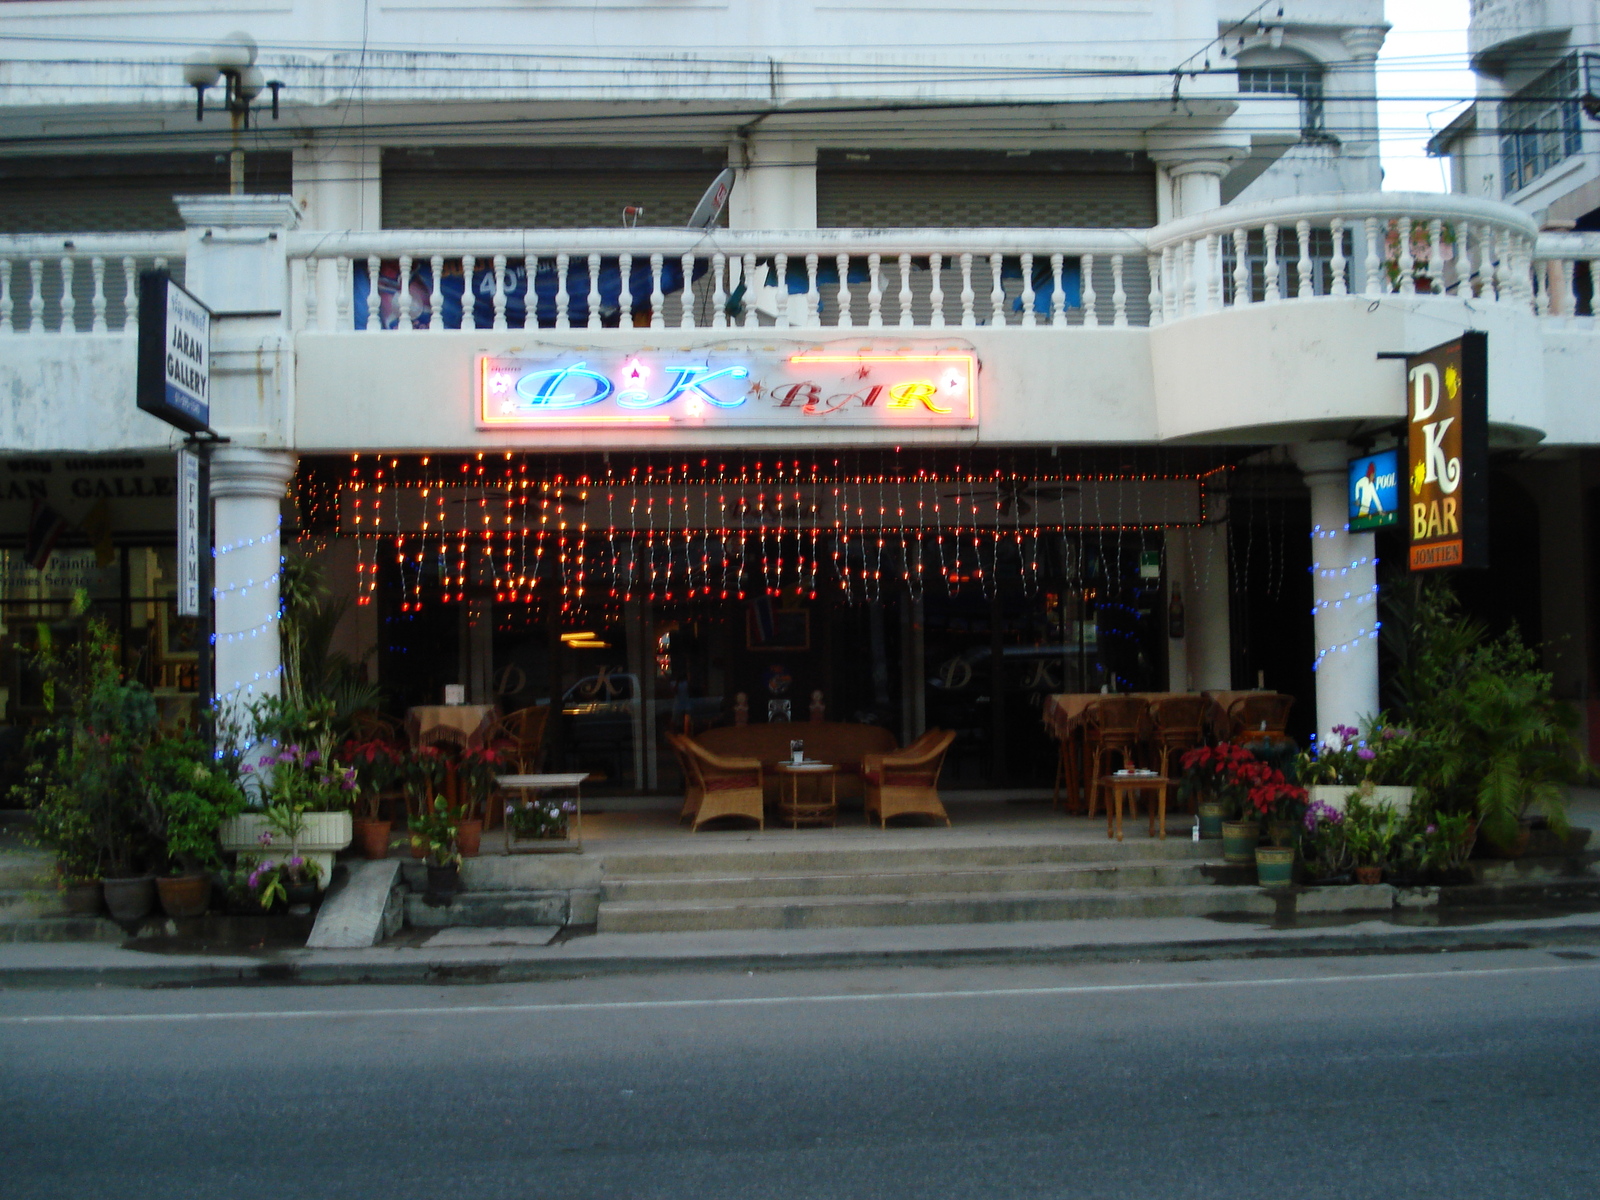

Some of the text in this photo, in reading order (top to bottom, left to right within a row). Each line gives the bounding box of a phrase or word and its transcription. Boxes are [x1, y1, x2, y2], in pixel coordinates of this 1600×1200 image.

[172, 324, 203, 365] JARAN
[167, 352, 207, 397] GALLERY
[770, 379, 952, 415] BAR
[0, 476, 177, 499] AN GALLE
[1376, 473, 1398, 491] POOL
[1413, 497, 1459, 541] BAR
[188, 482, 197, 608] FRAME
[1413, 544, 1460, 566] JOMTIEN
[51, 557, 98, 570] Paintin
